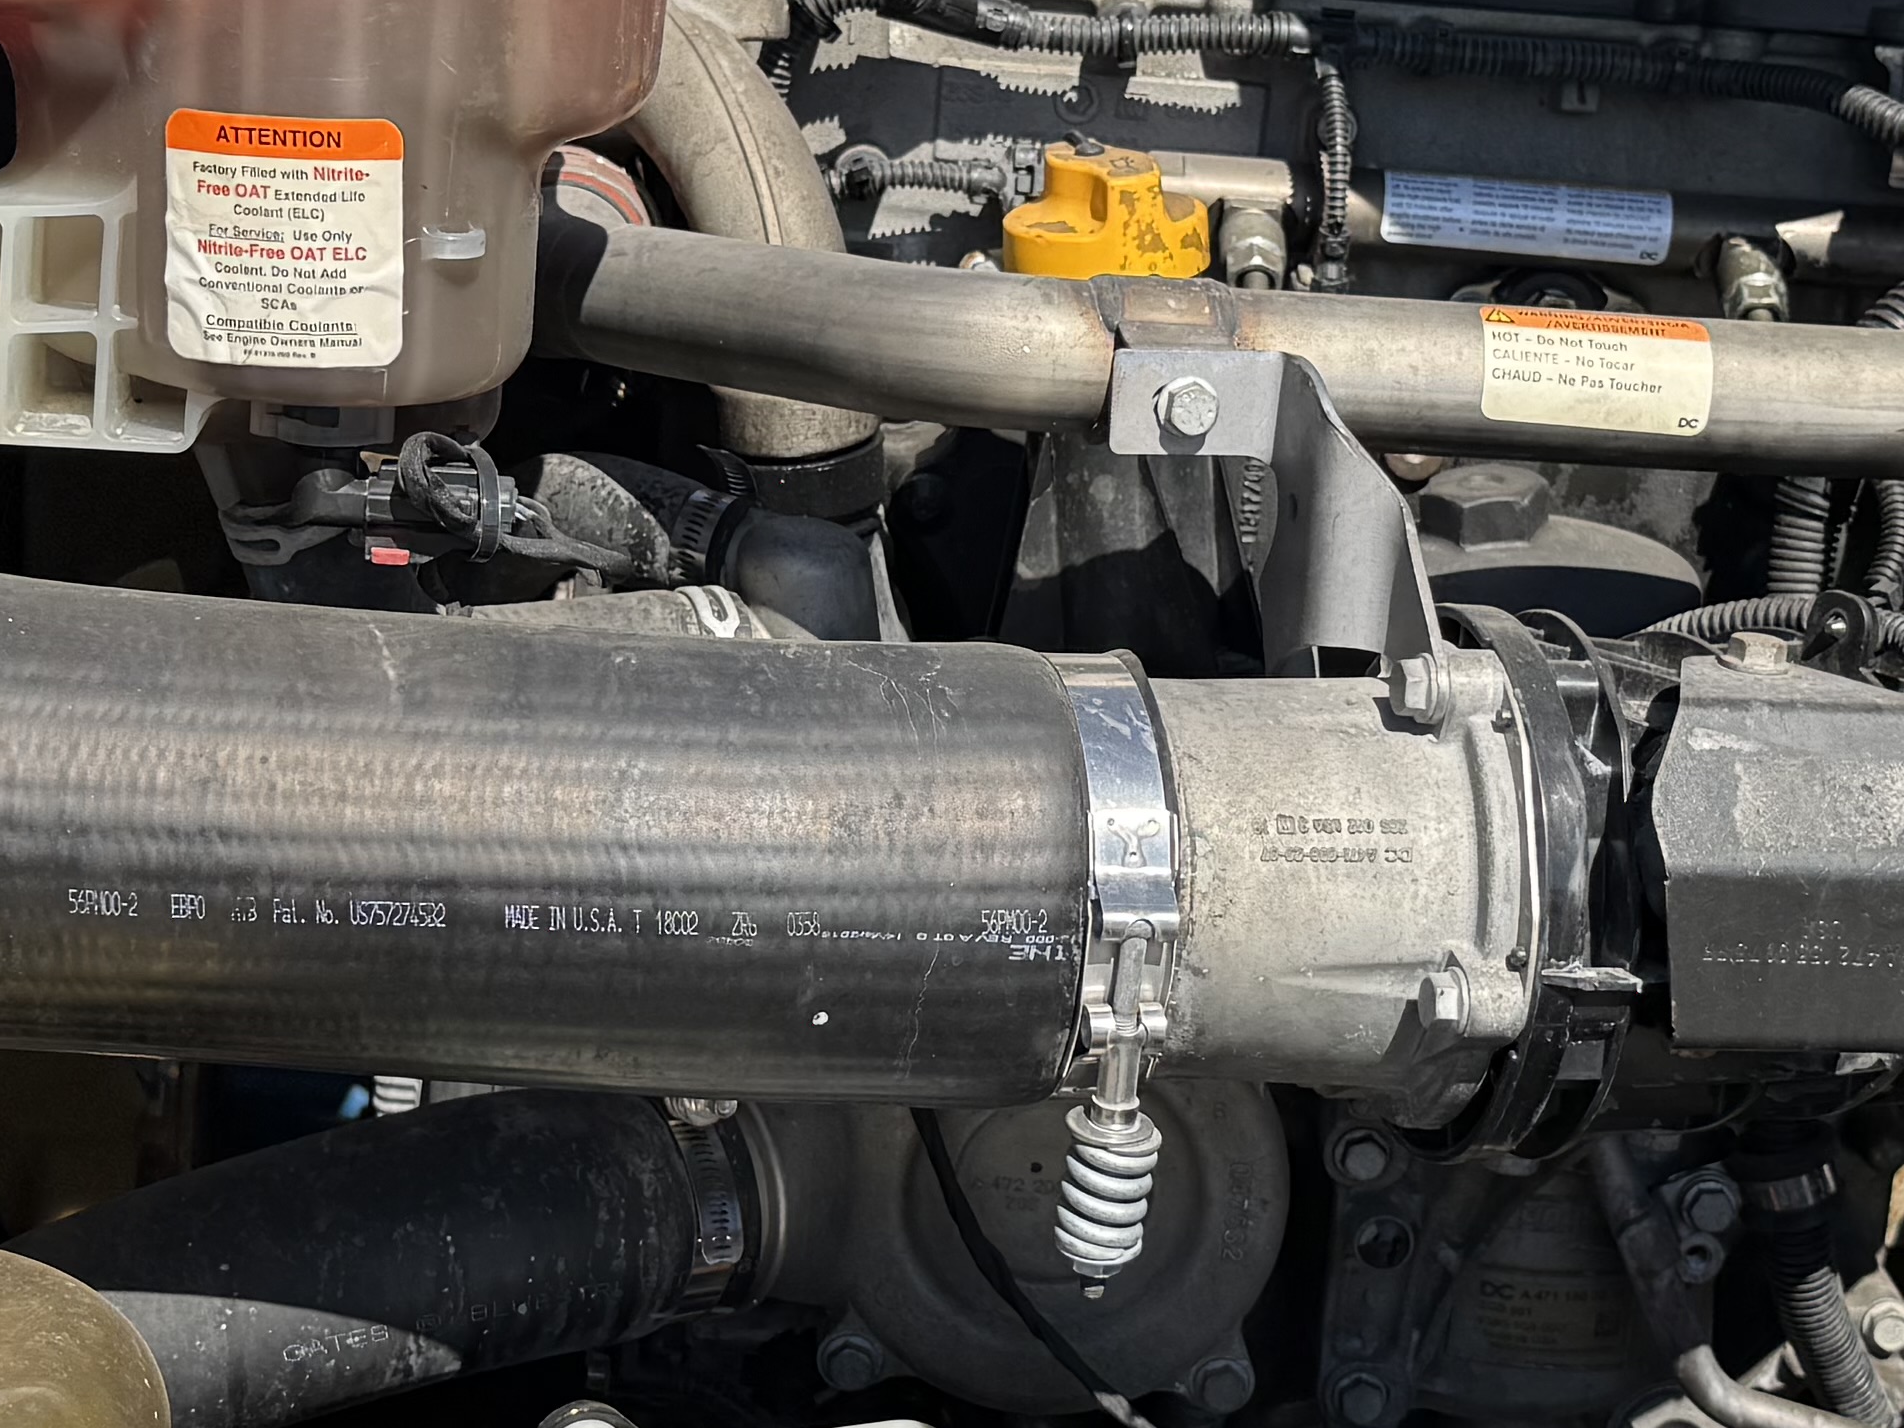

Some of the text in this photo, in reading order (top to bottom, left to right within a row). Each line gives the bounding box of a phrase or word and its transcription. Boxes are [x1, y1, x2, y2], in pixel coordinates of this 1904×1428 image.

[216, 125, 342, 149] ATTENTION
[193, 161, 237, 179] Factory
[241, 165, 276, 180] Filled
[281, 168, 309, 181] with
[197, 180, 366, 203] Free OAT Extended Life
[233, 204, 325, 223] Coolant (ELC)
[209, 224, 228, 238] For
[293, 229, 317, 243] Use
[322, 231, 352, 245] Only
[197, 239, 367, 261] Nitrite-Free OAT ELC
[271, 264, 289, 278] Do
[293, 267, 316, 279] Not
[320, 268, 347, 280] Add
[198, 277, 282, 294] Conventional
[206, 314, 284, 331] Compatible
[1492, 331, 1628, 352] HOT Do Not Touch
[1492, 349, 1635, 371] CALIENTE No Tocar
[1492, 368, 1662, 394] CHAUD Ne Pas Toucher
[1677, 417, 1699, 429] DC
[273, 897, 306, 925] Pat.
[316, 900, 339, 925] No.
[505, 904, 540, 930] MADE
[548, 906, 567, 930] IN
[572, 906, 623, 932] U.S.A.
[633, 908, 643, 932] T
[1480, 1280, 1515, 1300] DC
